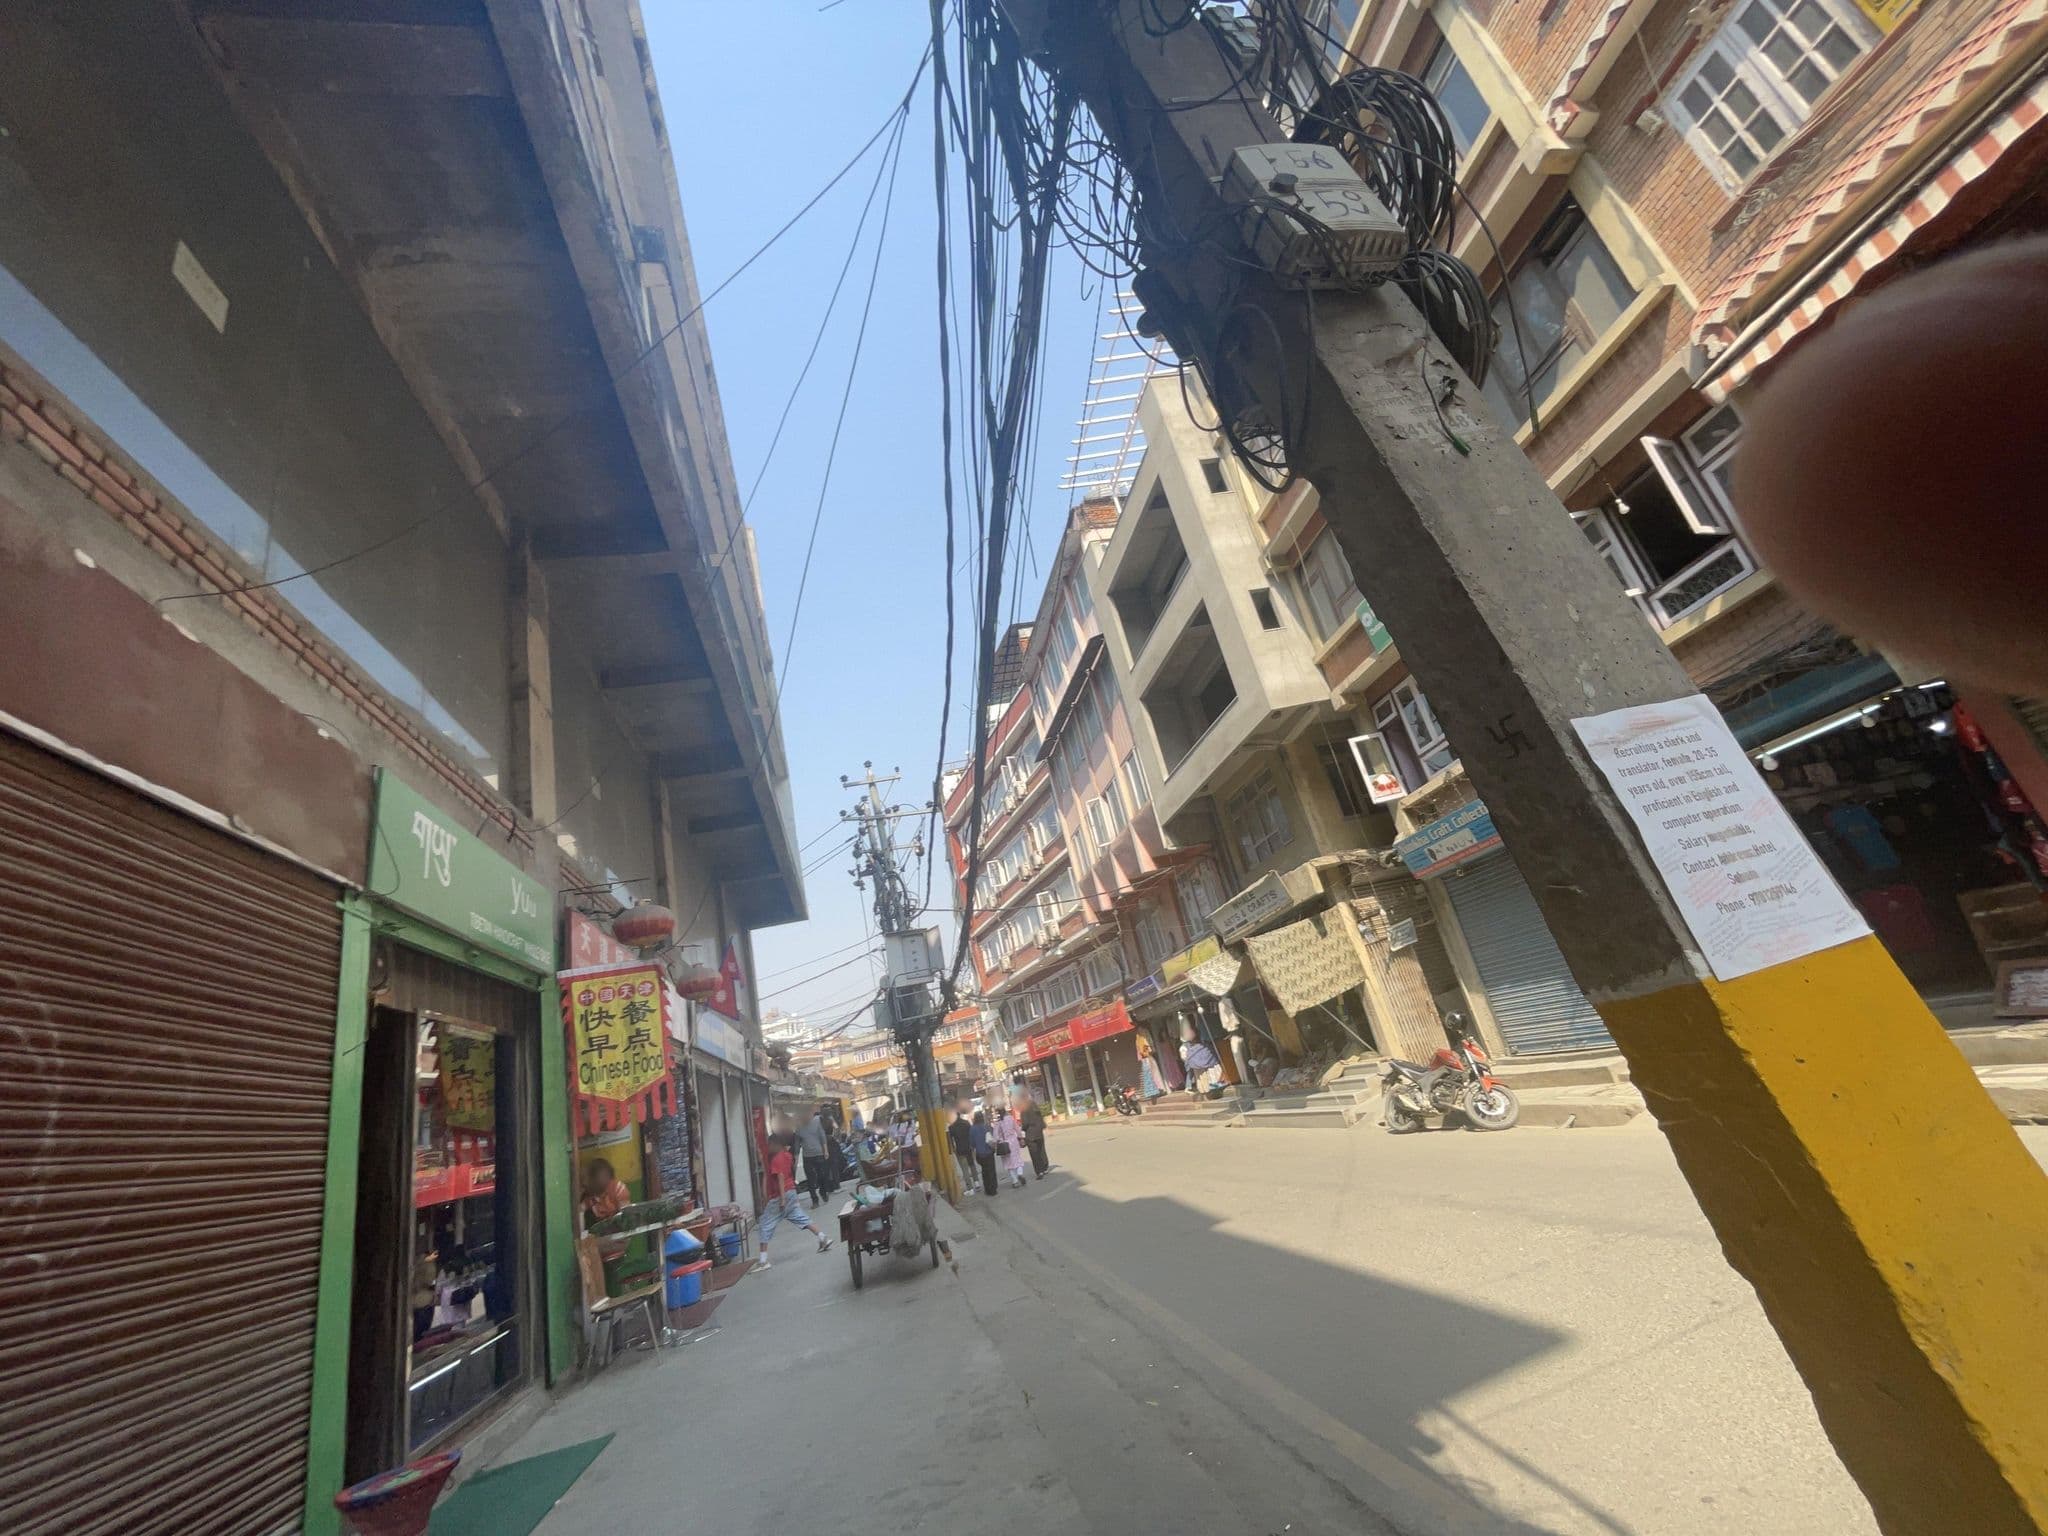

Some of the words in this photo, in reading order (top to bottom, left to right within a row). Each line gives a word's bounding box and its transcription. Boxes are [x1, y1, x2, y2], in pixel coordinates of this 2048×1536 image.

[1613, 742, 1659, 759] Recruiting
[1656, 741, 1664, 750] a
[1664, 735, 1686, 748] clerk
[1685, 732, 1702, 744] and
[1618, 760, 1664, 778] translator,
[1692, 746, 1719, 761] 20-35
[1627, 782, 1653, 799] years
[1652, 779, 1670, 793] old,
[1668, 775, 1688, 787] over
[1713, 763, 1733, 775] tall,
[1642, 795, 1684, 816] proficient
[1681, 793, 1694, 805] in
[1690, 786, 1725, 802] English
[1722, 781, 1741, 794] and
[1428, 822, 1453, 841] Craft
[1662, 813, 1702, 830] computer
[1678, 832, 1710, 851] Salary
[1682, 856, 1719, 874] Contact
[581, 1028, 657, 1059] 早点
[580, 1060, 630, 1085] Chinese
[632, 1050, 663, 1075] Food
